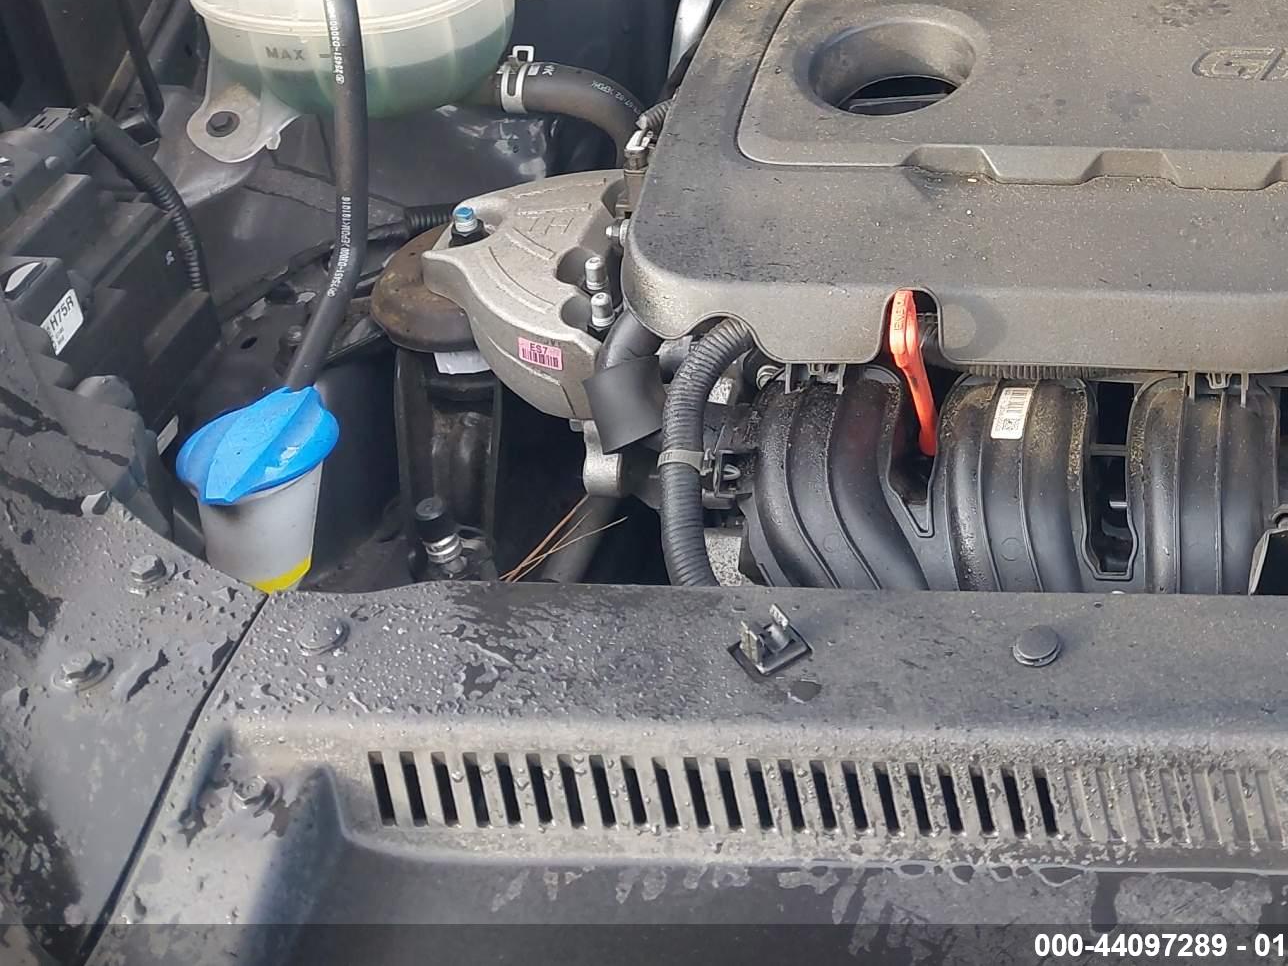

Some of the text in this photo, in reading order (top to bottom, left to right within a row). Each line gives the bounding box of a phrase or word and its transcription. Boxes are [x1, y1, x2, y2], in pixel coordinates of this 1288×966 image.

[266, 46, 305, 60] MAX
[49, 295, 74, 331] H75R
[529, 342, 548, 355] ES7
